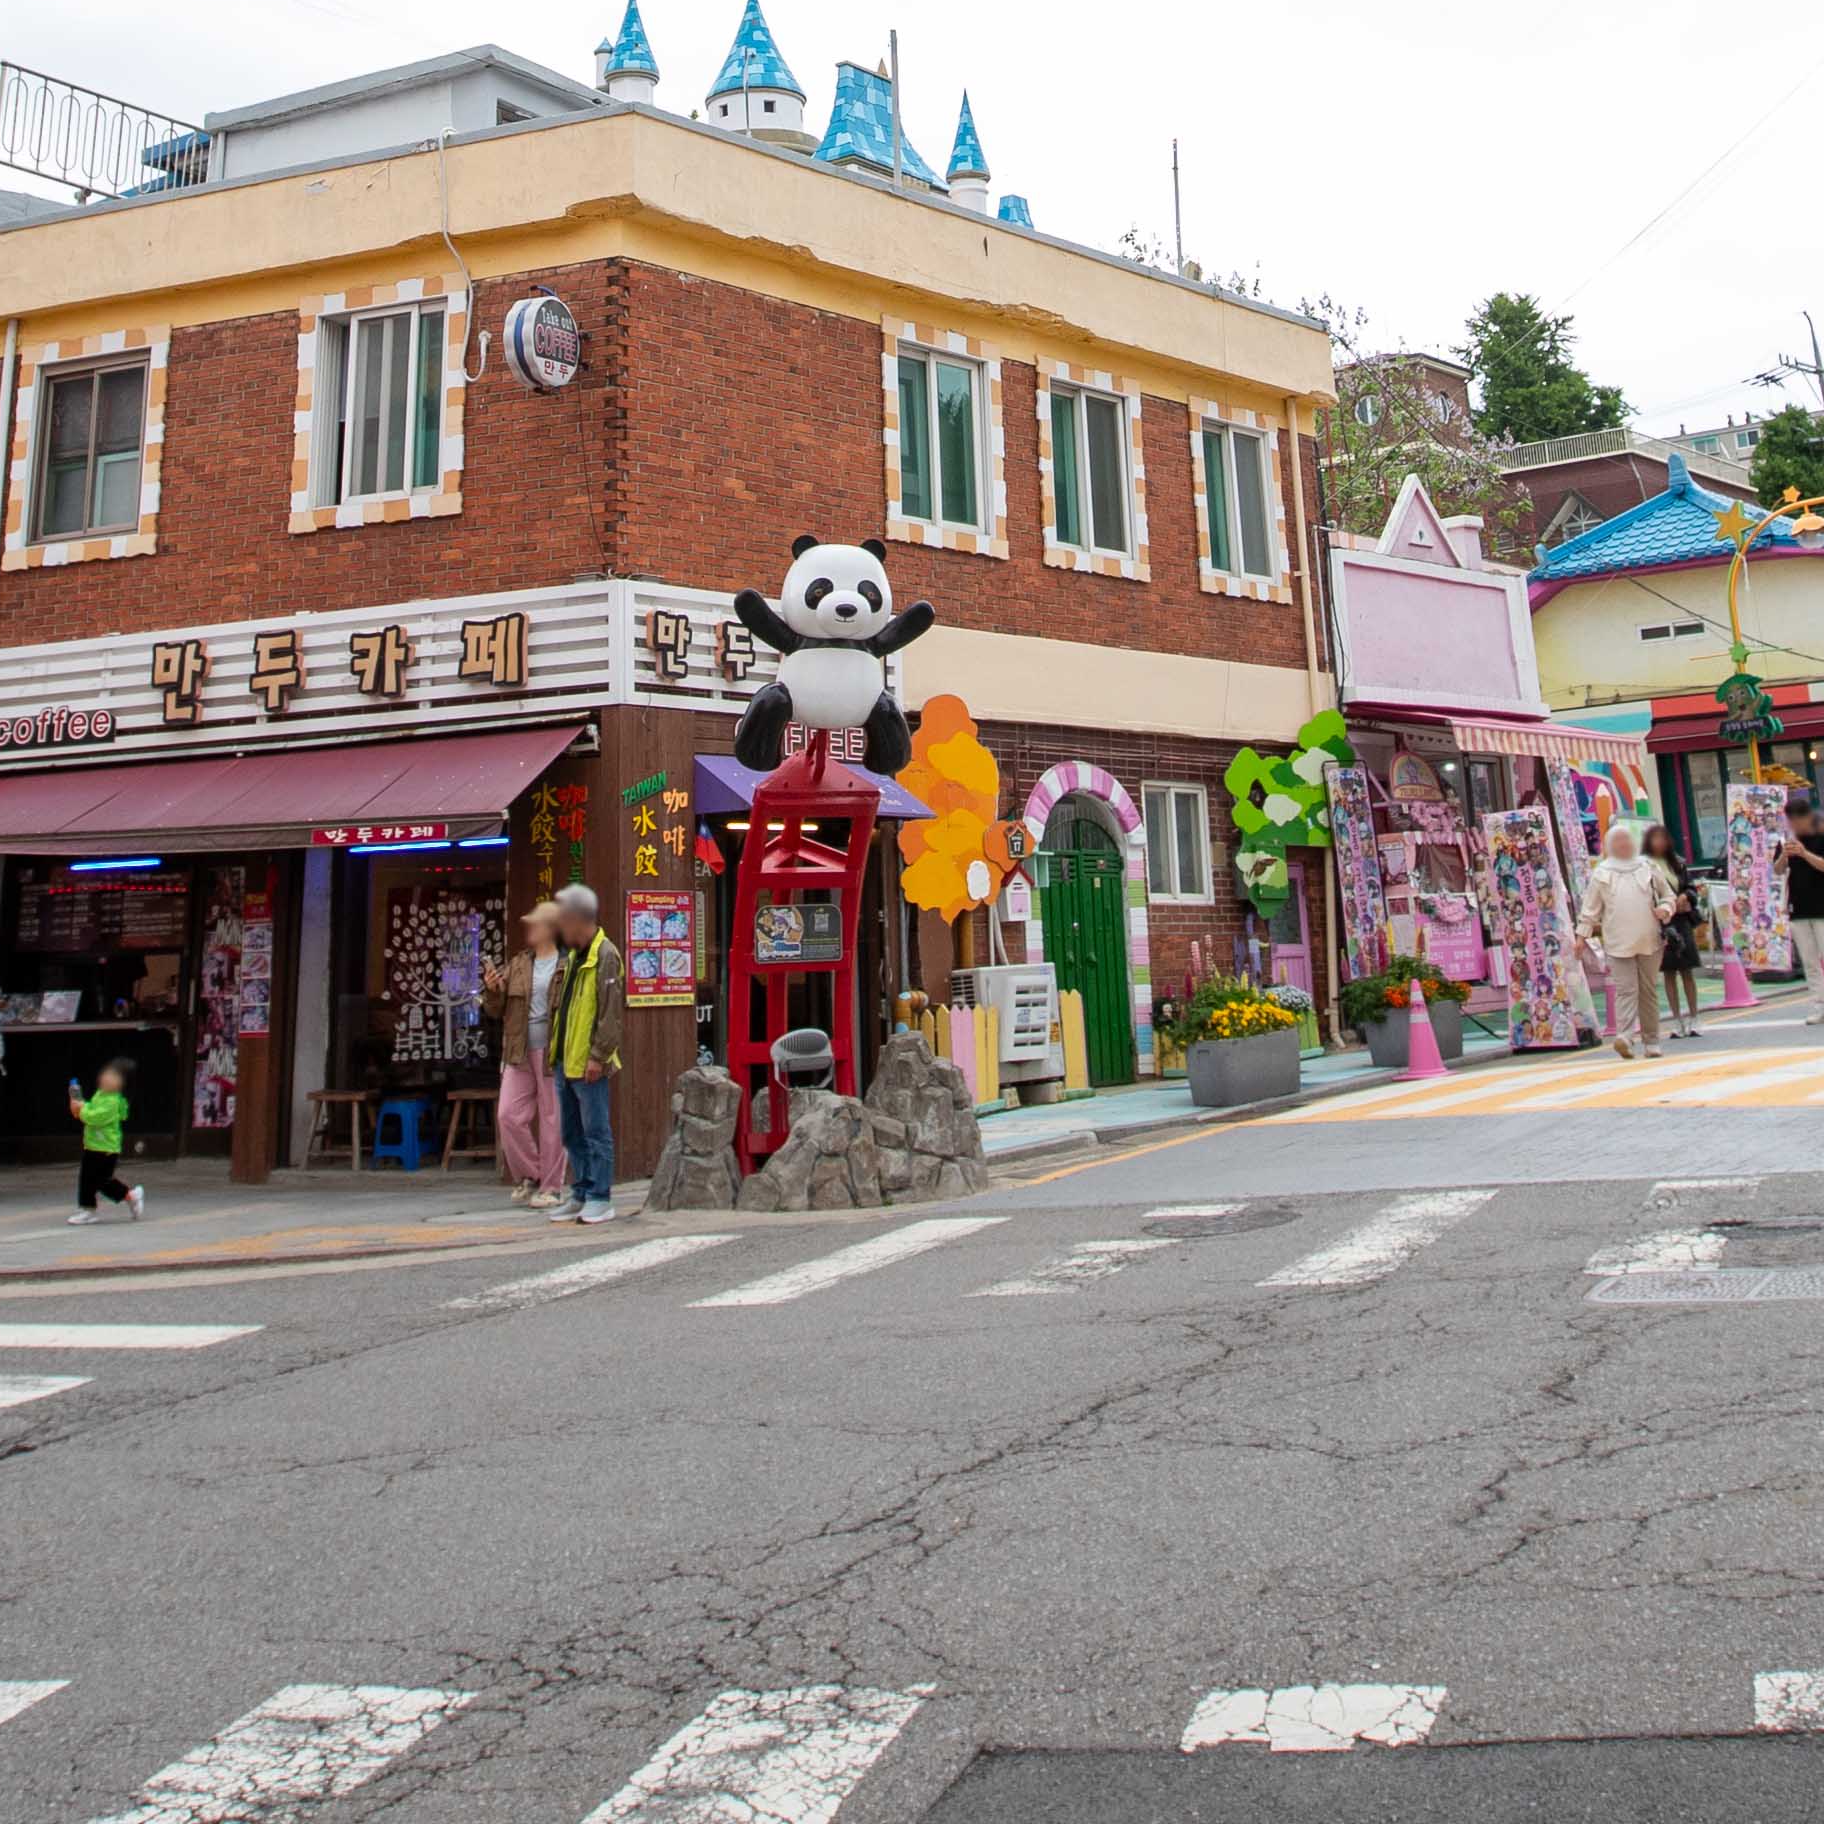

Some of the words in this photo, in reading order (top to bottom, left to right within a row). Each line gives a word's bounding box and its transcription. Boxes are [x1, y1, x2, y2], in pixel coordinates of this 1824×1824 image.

[541, 307, 559, 326] Take
[536, 323, 576, 363] COFFEE
[544, 360, 569, 379] 만두
[151, 612, 531, 723] 만두카페
[622, 770, 667, 808] TAIWAN
[531, 784, 559, 845] 水餃
[663, 788, 689, 857] 咖啡
[324, 826, 434, 844] 만두카페
[632, 804, 658, 876] 水餃
